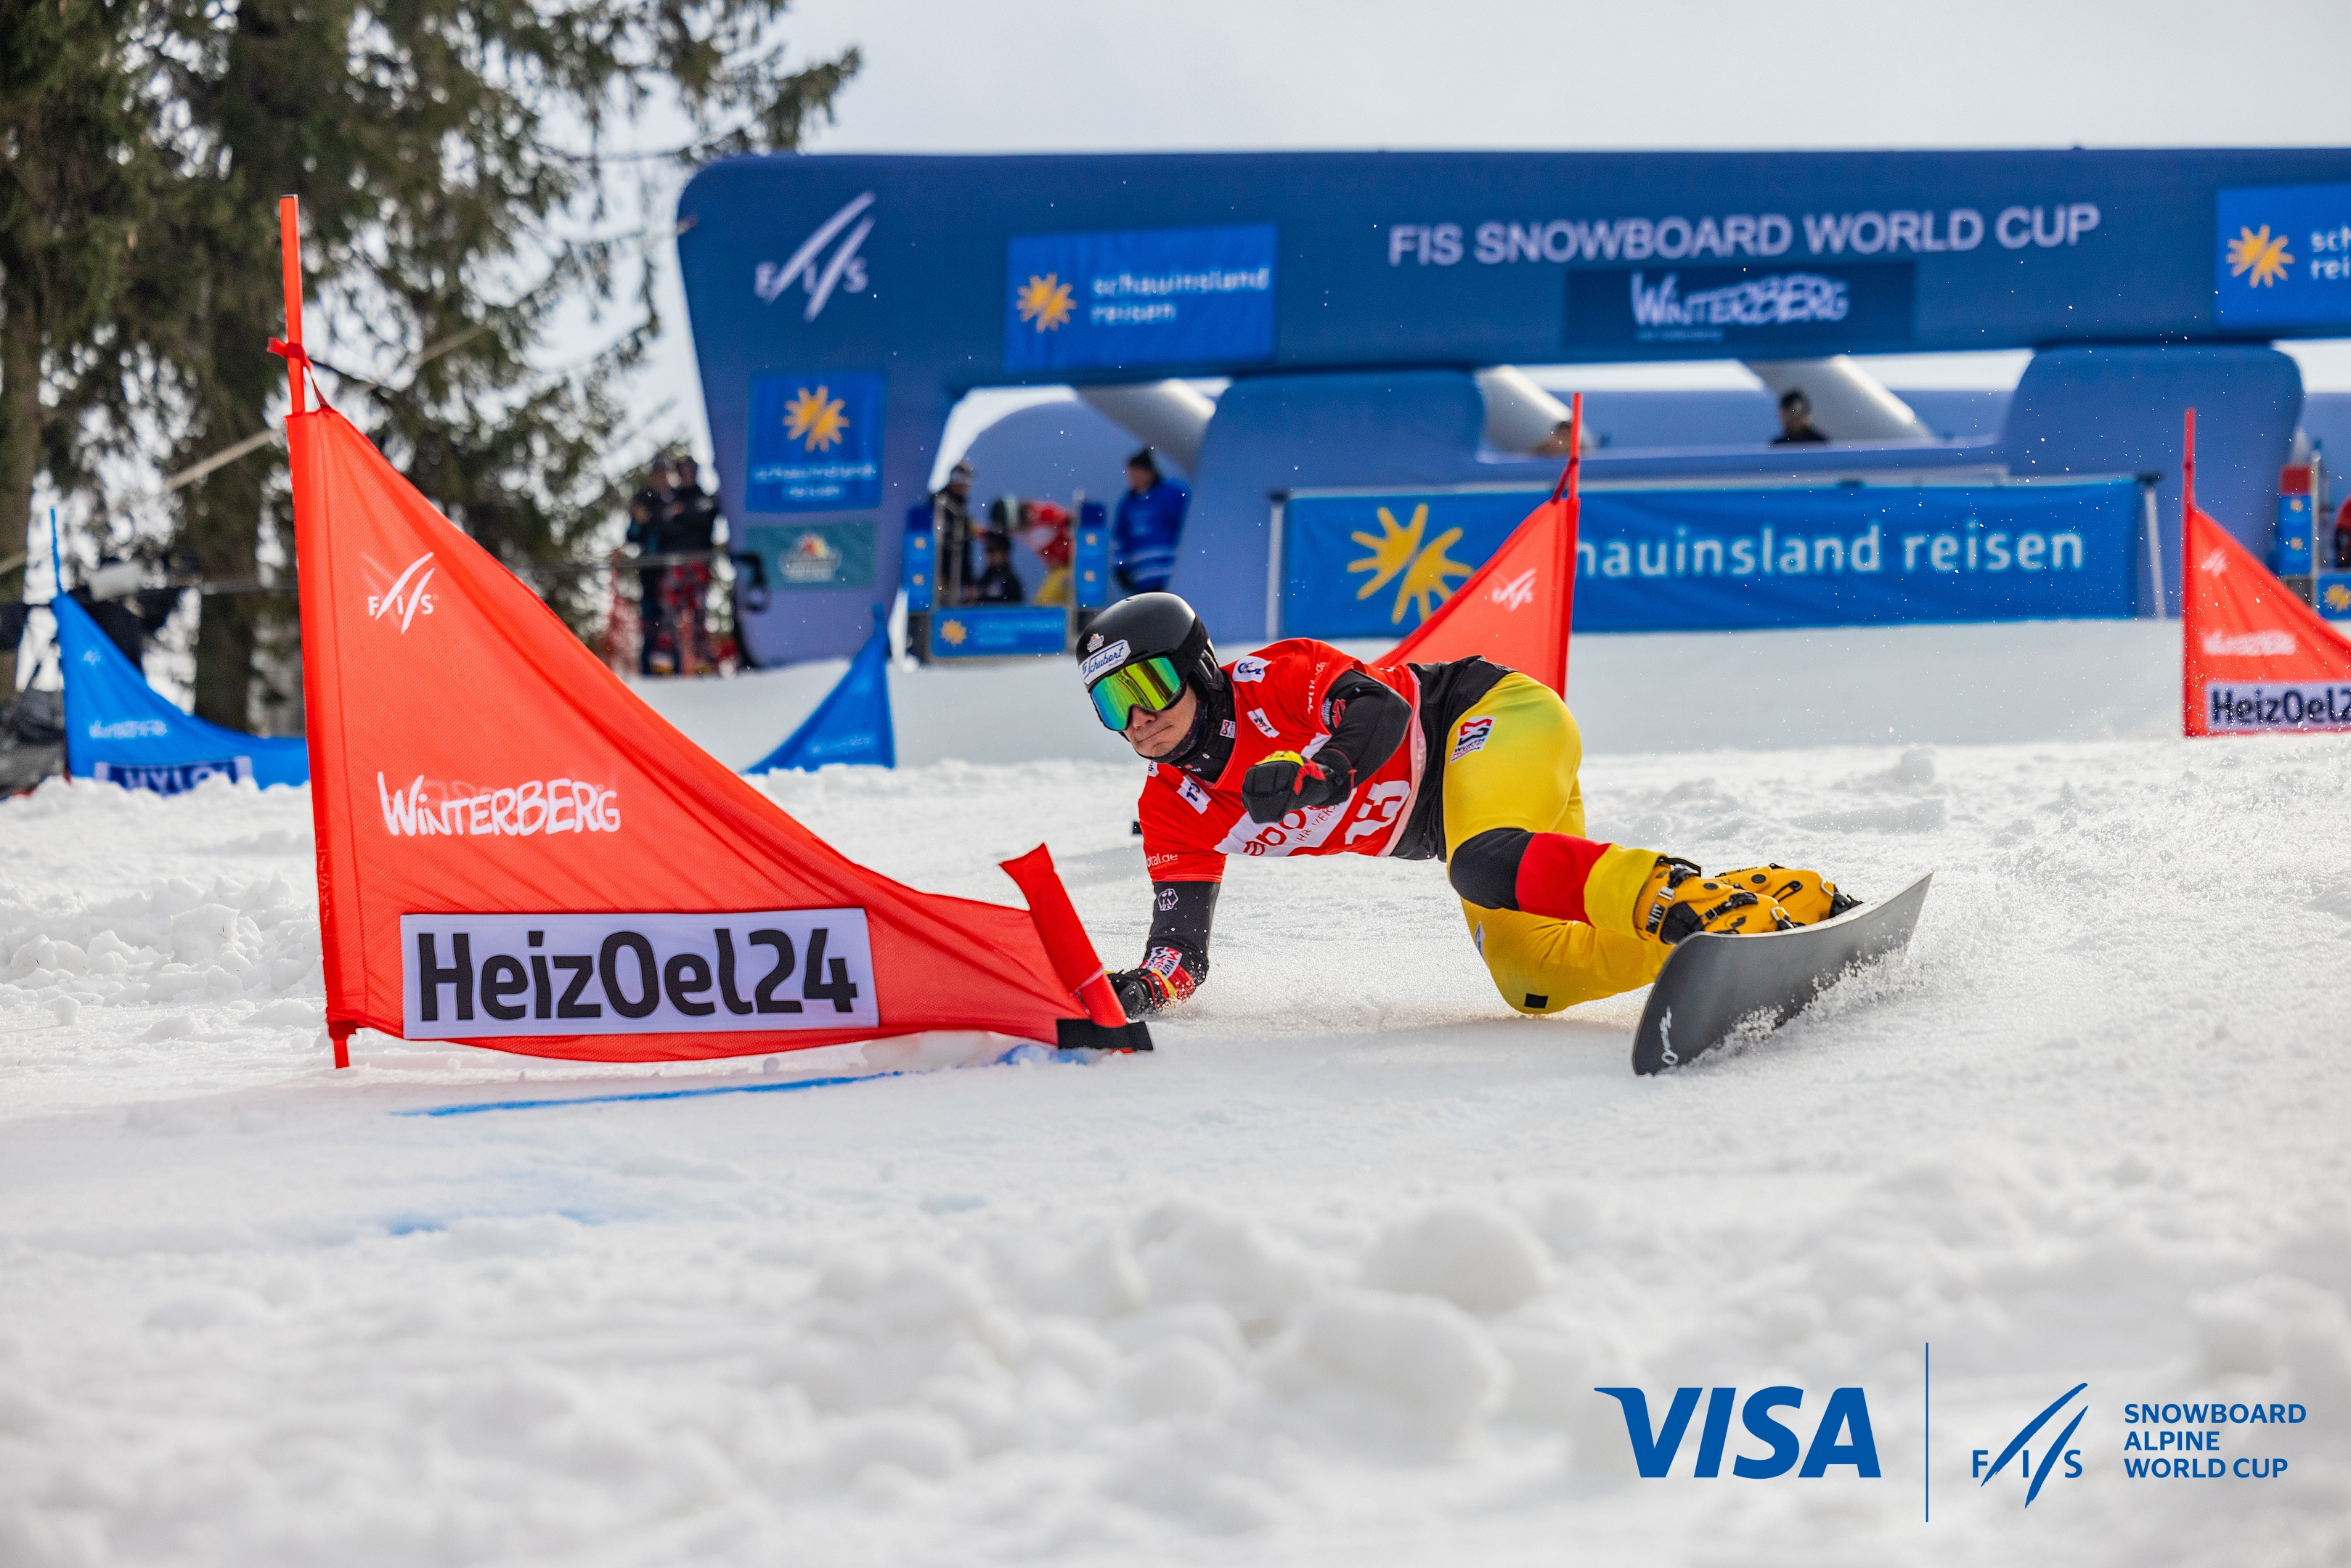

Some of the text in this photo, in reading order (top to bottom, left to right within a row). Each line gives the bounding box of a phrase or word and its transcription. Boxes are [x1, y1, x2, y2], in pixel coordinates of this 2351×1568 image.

[1389, 203, 2100, 266] FIS SNOWBOARD WORLD CUP
[1904, 520, 2084, 572] reisen
[417, 928, 857, 1021] HeizOel24
